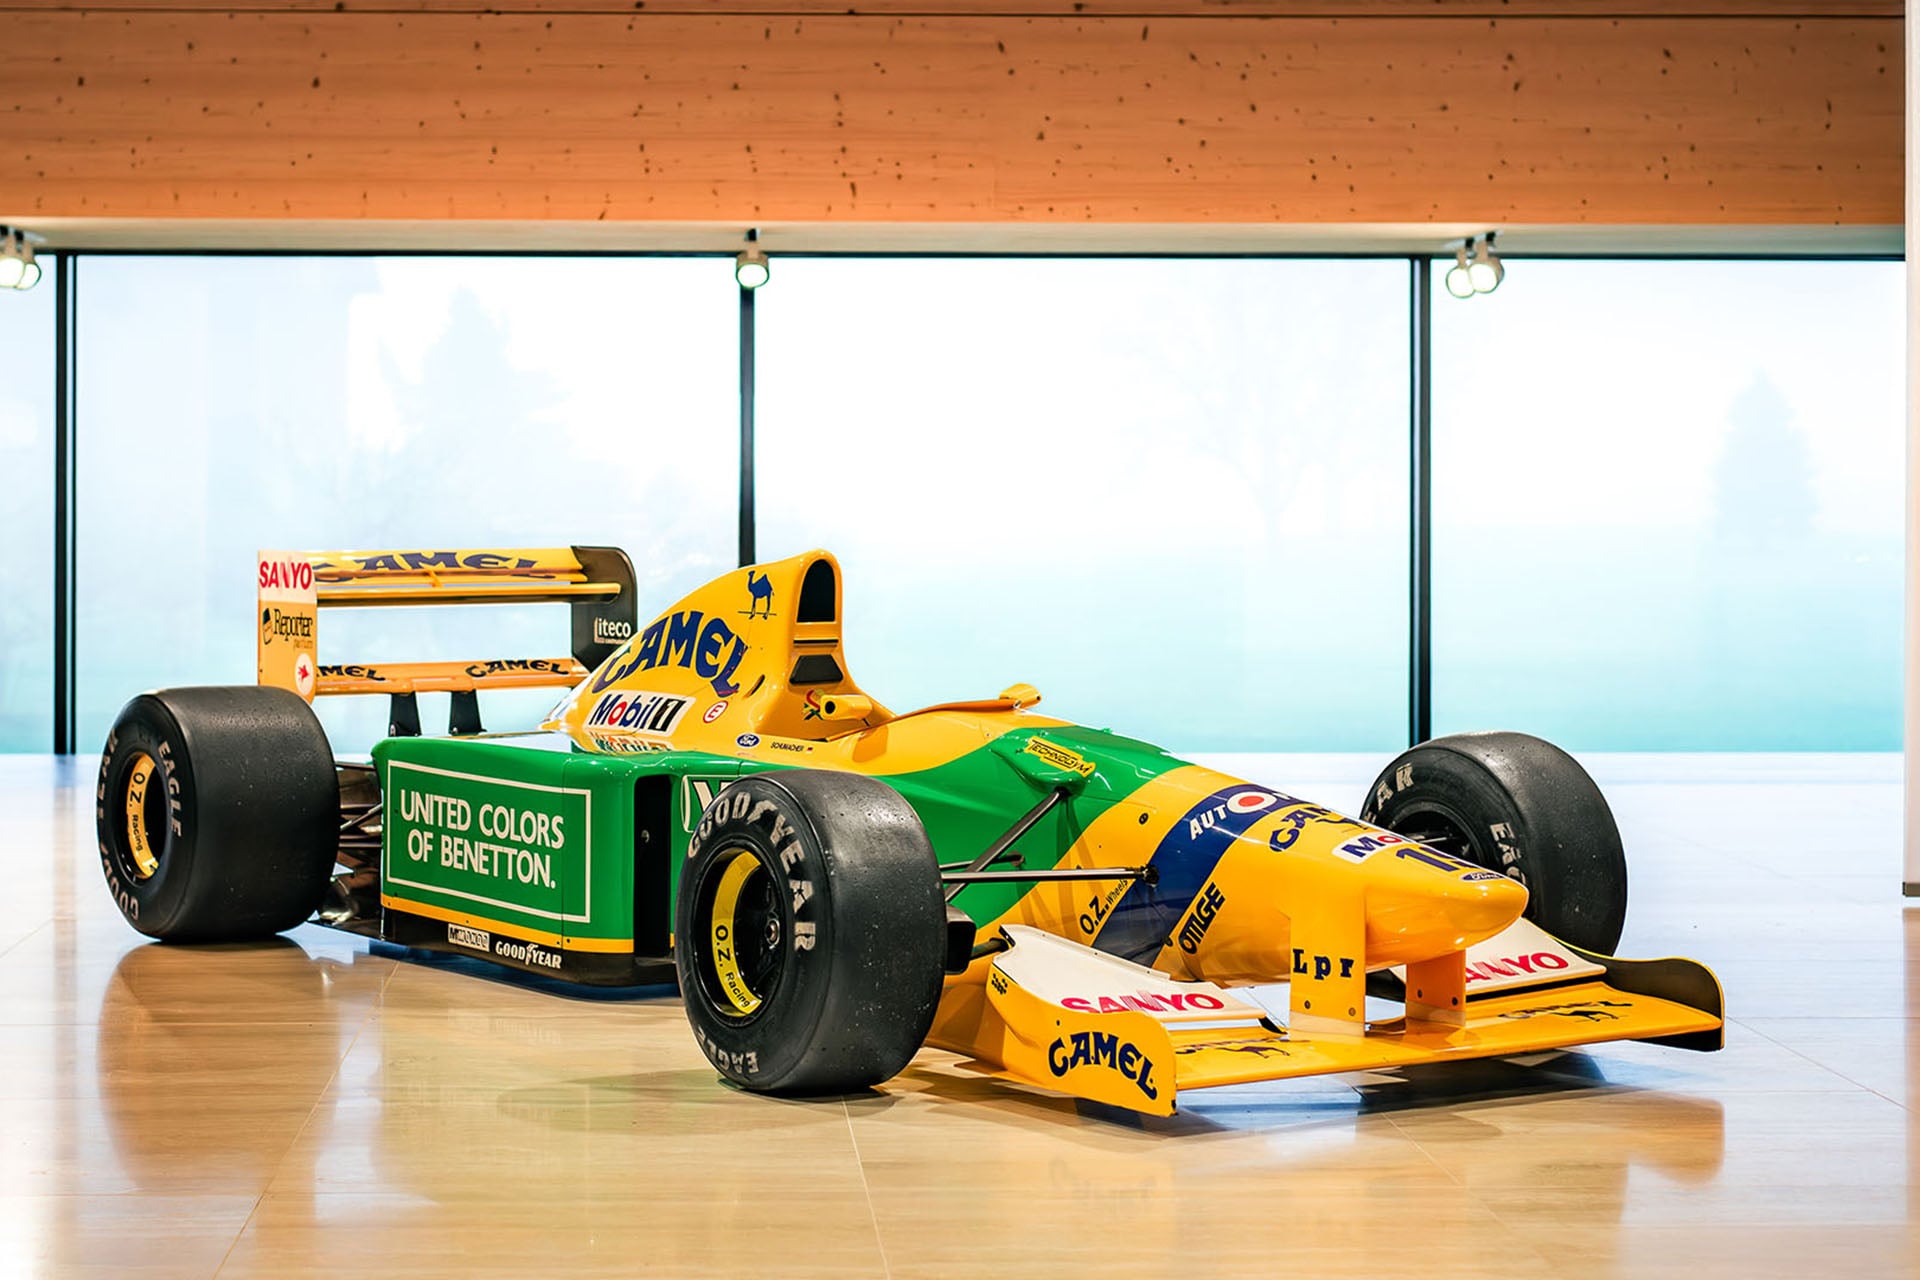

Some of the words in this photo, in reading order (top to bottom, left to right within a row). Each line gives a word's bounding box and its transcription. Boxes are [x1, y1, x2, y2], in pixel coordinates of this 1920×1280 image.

[260, 560, 312, 590] SANYO
[273, 608, 313, 641] Reporter
[466, 660, 569, 678] CAMEL
[592, 610, 748, 698] CAMEL
[317, 665, 386, 681] MEL
[588, 694, 664, 729] Mobil
[1027, 739, 1093, 774] TECHNOGYM
[157, 740, 183, 838] EAGLE
[131, 814, 144, 851] Racing
[400, 789, 471, 831] UNITED
[479, 804, 564, 849] COLORS
[407, 828, 433, 863] OF
[440, 834, 556, 889] BENETTON.
[688, 791, 816, 951] GOODYEAR
[1106, 878, 1128, 905] Wheels
[496, 942, 561, 968] GOODYEAR
[715, 925, 731, 967] O.Z.
[725, 971, 750, 1008] Racing
[1466, 953, 1569, 983] ANYO
[1060, 990, 1225, 1013] SANYO
[697, 1024, 759, 1074] EAGLE
[1048, 1031, 1157, 1100] CAMEL
